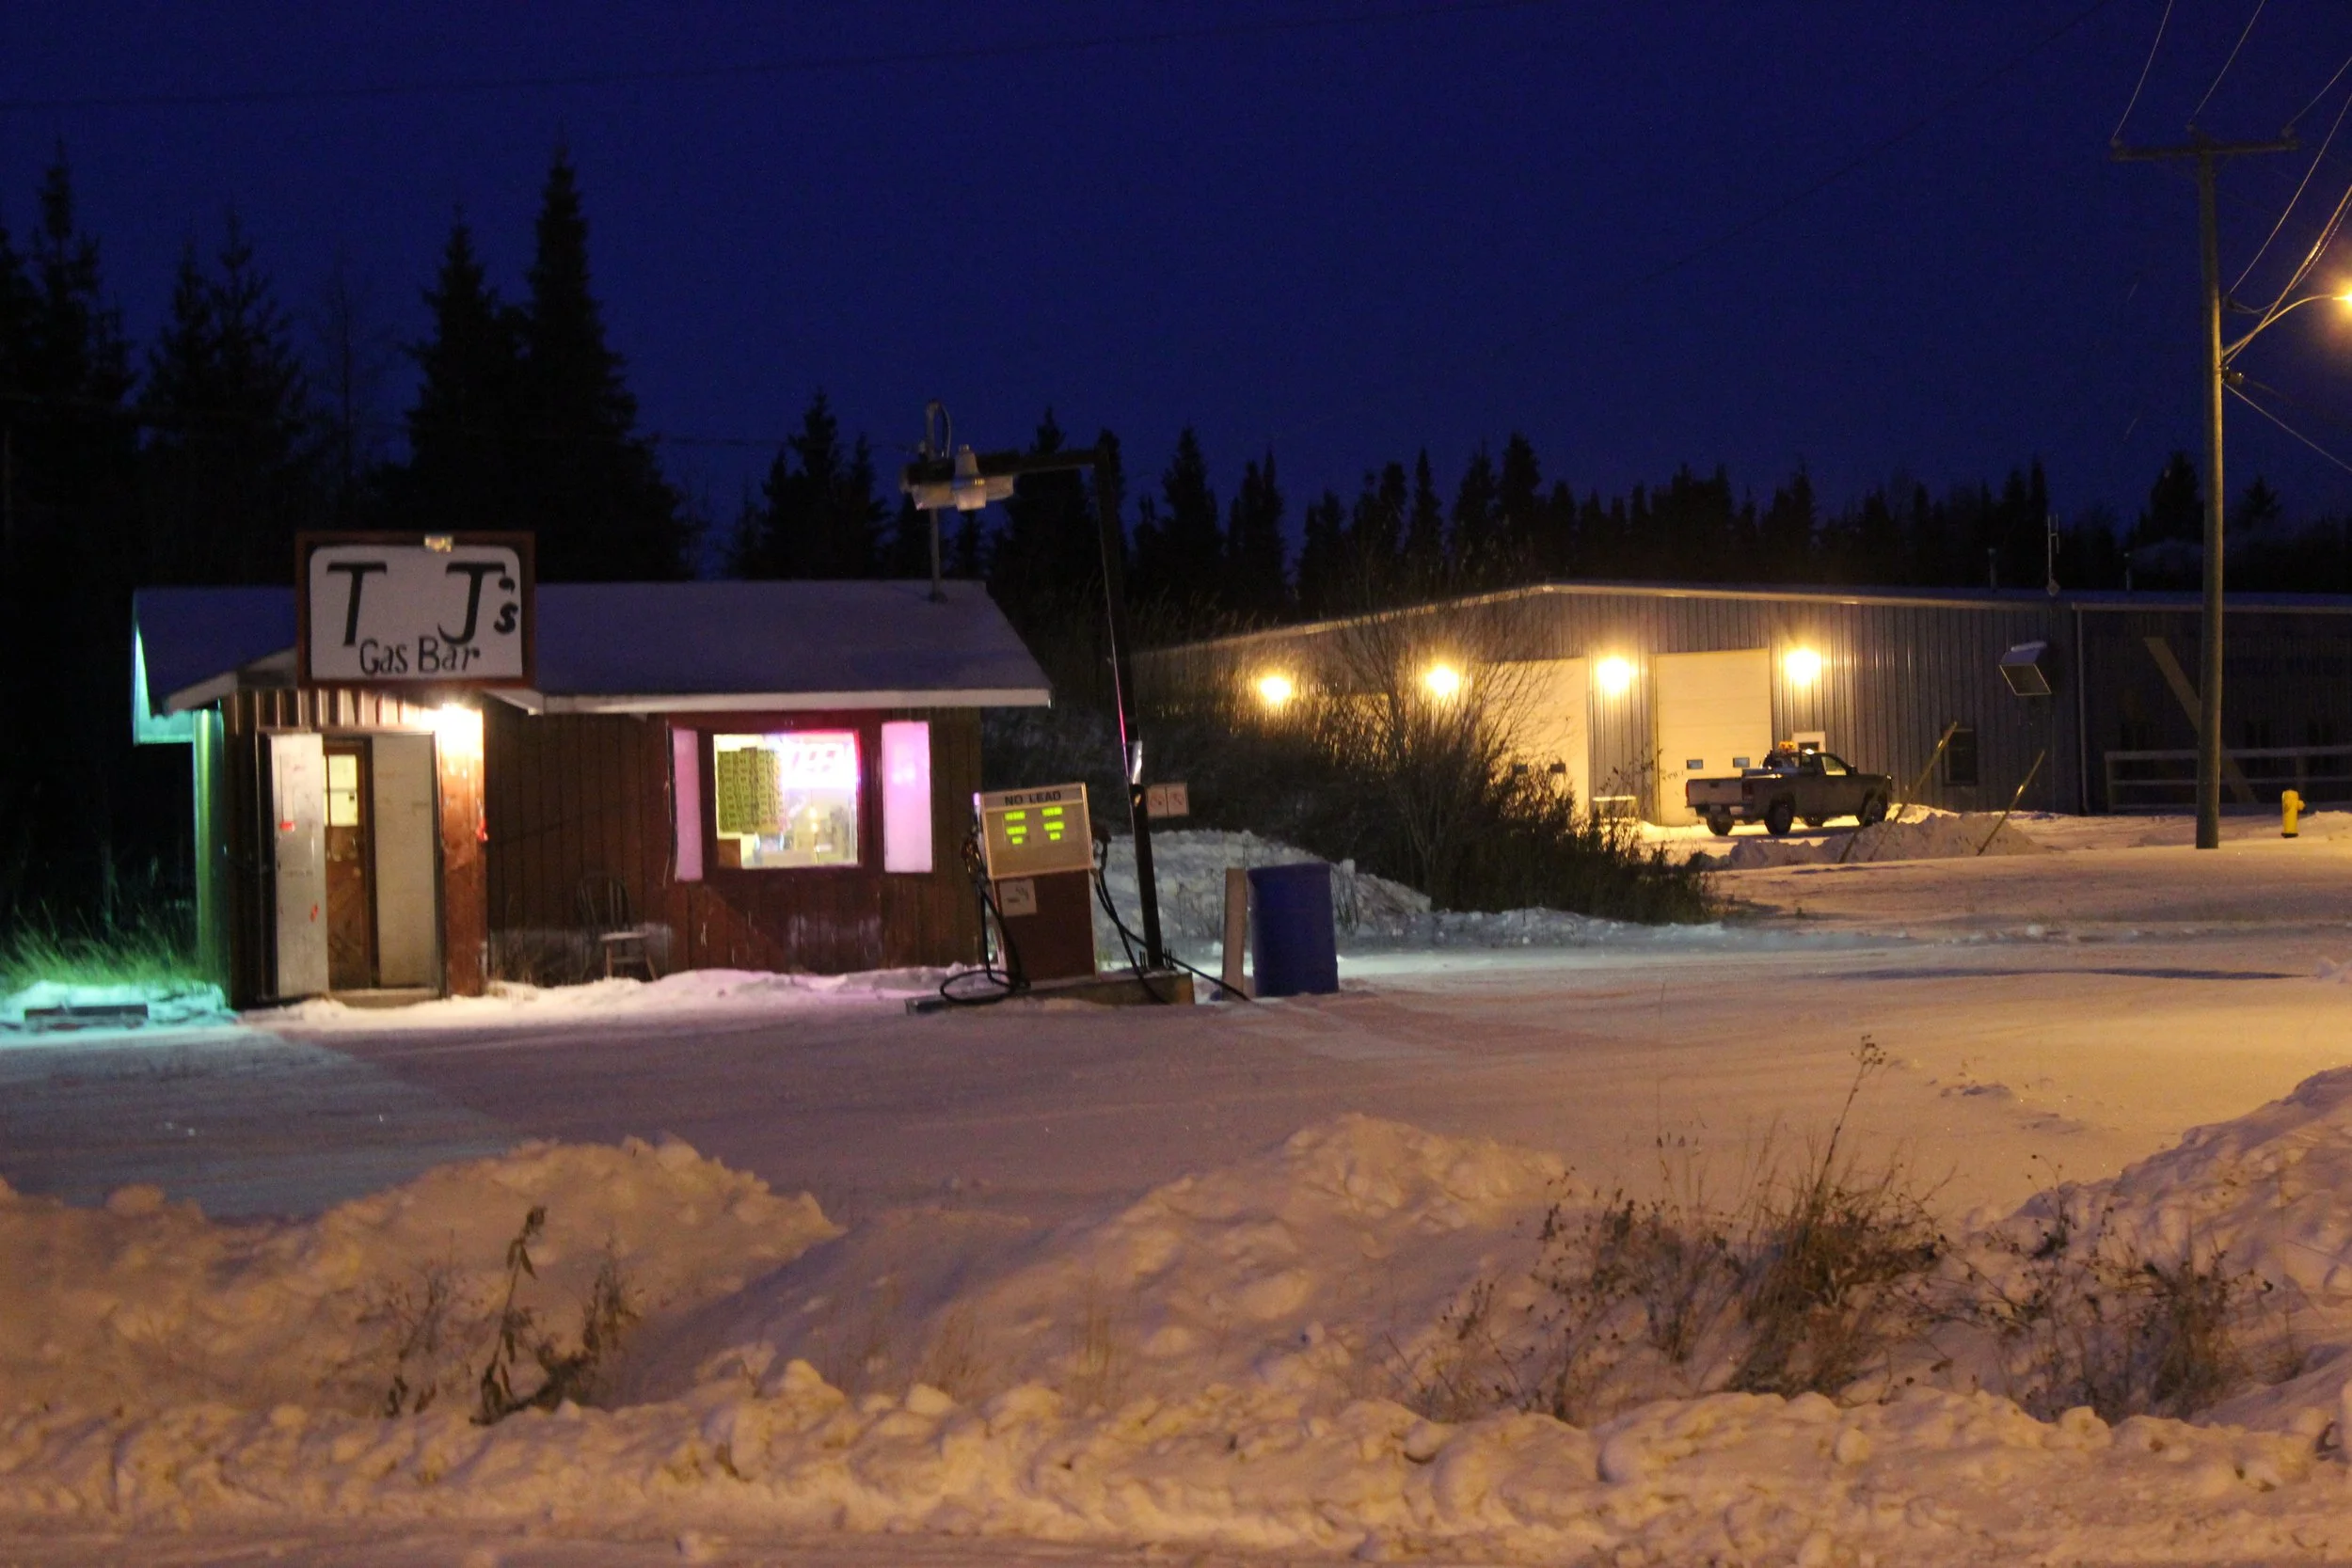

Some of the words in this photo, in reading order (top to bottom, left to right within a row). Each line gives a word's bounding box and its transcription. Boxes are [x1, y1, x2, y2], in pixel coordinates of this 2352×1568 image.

[359, 638, 408, 674] Gas
[418, 636, 481, 673] Bar
[1005, 795, 1024, 806] NO
[1029, 790, 1061, 803] LEAD
